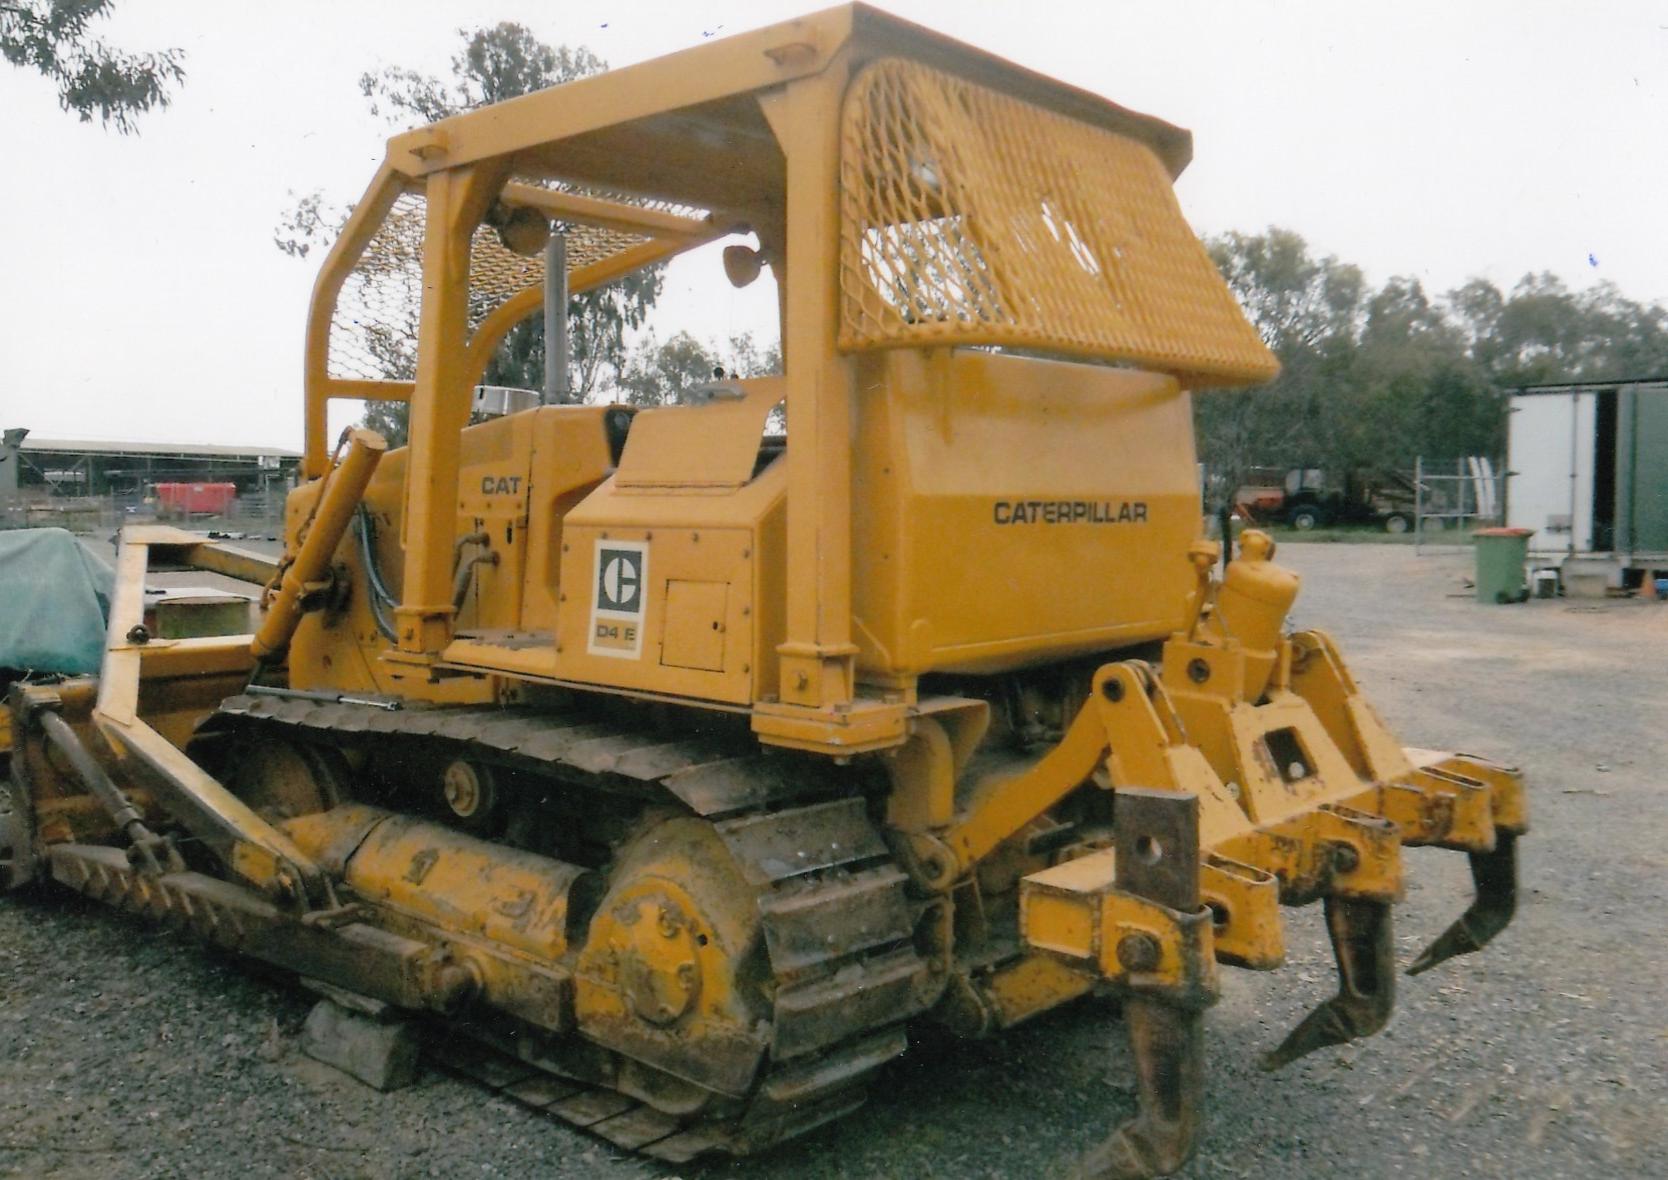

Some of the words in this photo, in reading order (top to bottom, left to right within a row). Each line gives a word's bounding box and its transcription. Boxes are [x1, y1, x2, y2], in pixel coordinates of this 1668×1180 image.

[481, 476, 522, 494] CAT
[993, 501, 1148, 525] CATERPILLAR
[596, 624, 618, 639] D4
[624, 626, 636, 641] E
